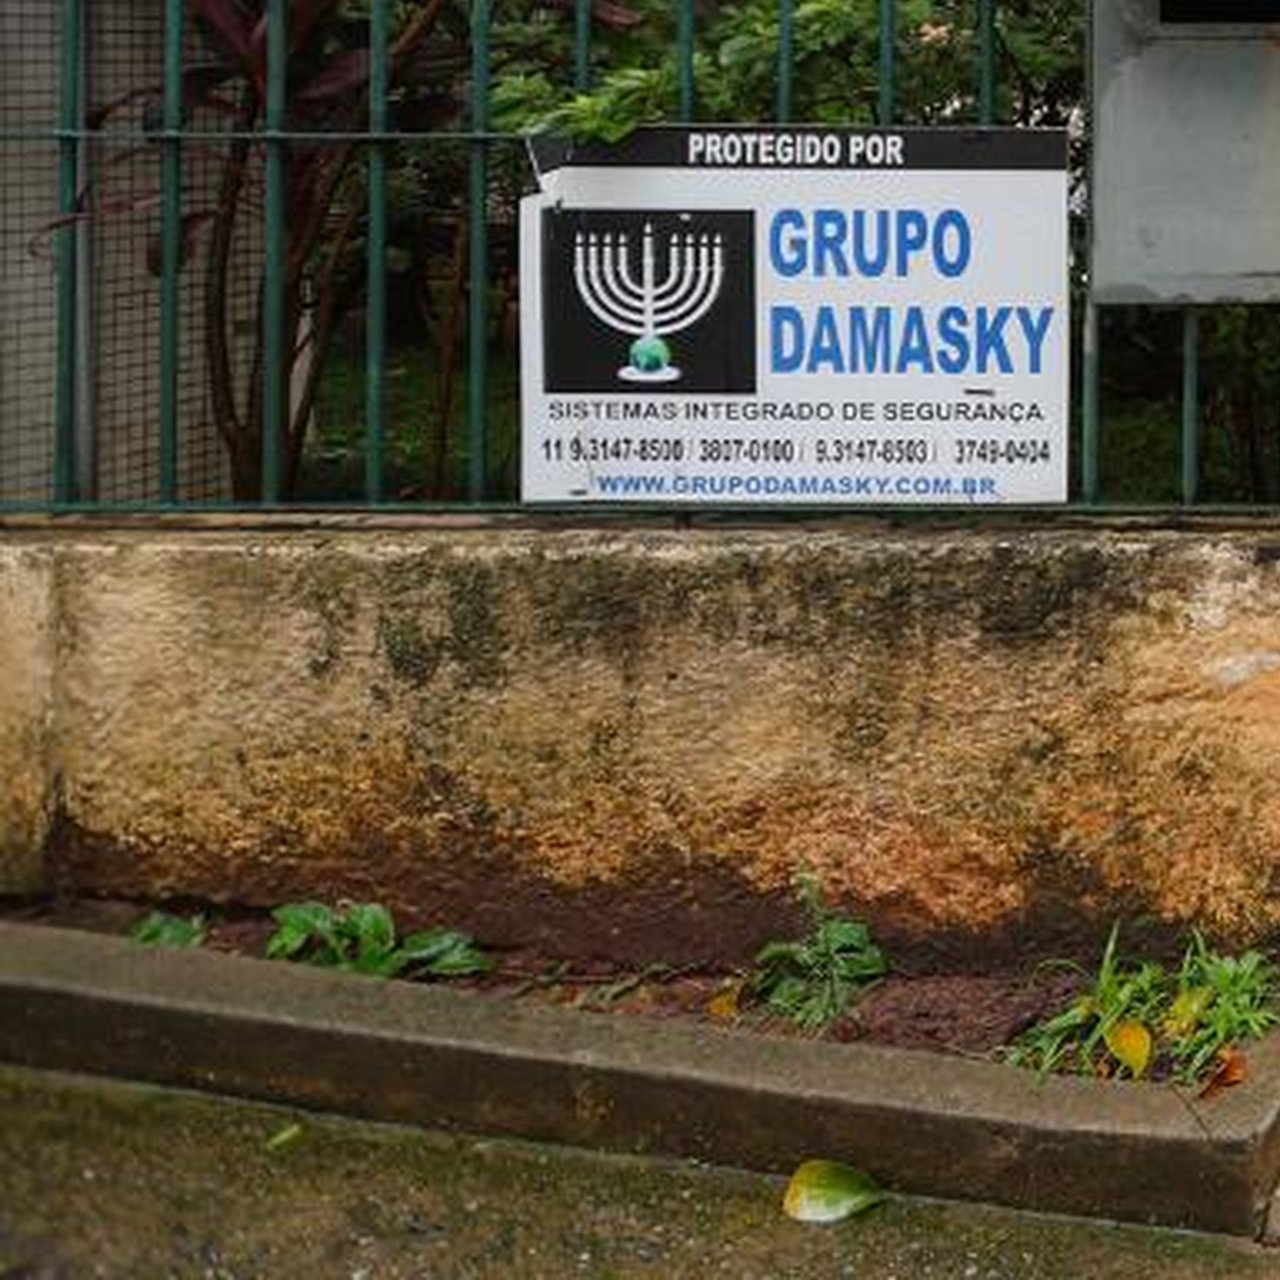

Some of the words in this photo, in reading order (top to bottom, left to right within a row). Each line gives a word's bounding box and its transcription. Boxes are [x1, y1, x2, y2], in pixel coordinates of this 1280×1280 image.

[688, 133, 842, 165] PROTEGIDO
[849, 133, 905, 165] POR
[769, 208, 971, 278] GRUPO
[770, 306, 1055, 375] DAMASKY
[548, 401, 678, 421] SISTEMAS
[685, 401, 833, 421] INTEGRADO
[842, 402, 875, 421] DE
[883, 402, 1045, 424] SEGURANÇA
[542, 439, 562, 461] 11
[597, 476, 996, 495] WWW.GRUPODAMASKY.COM.BR
